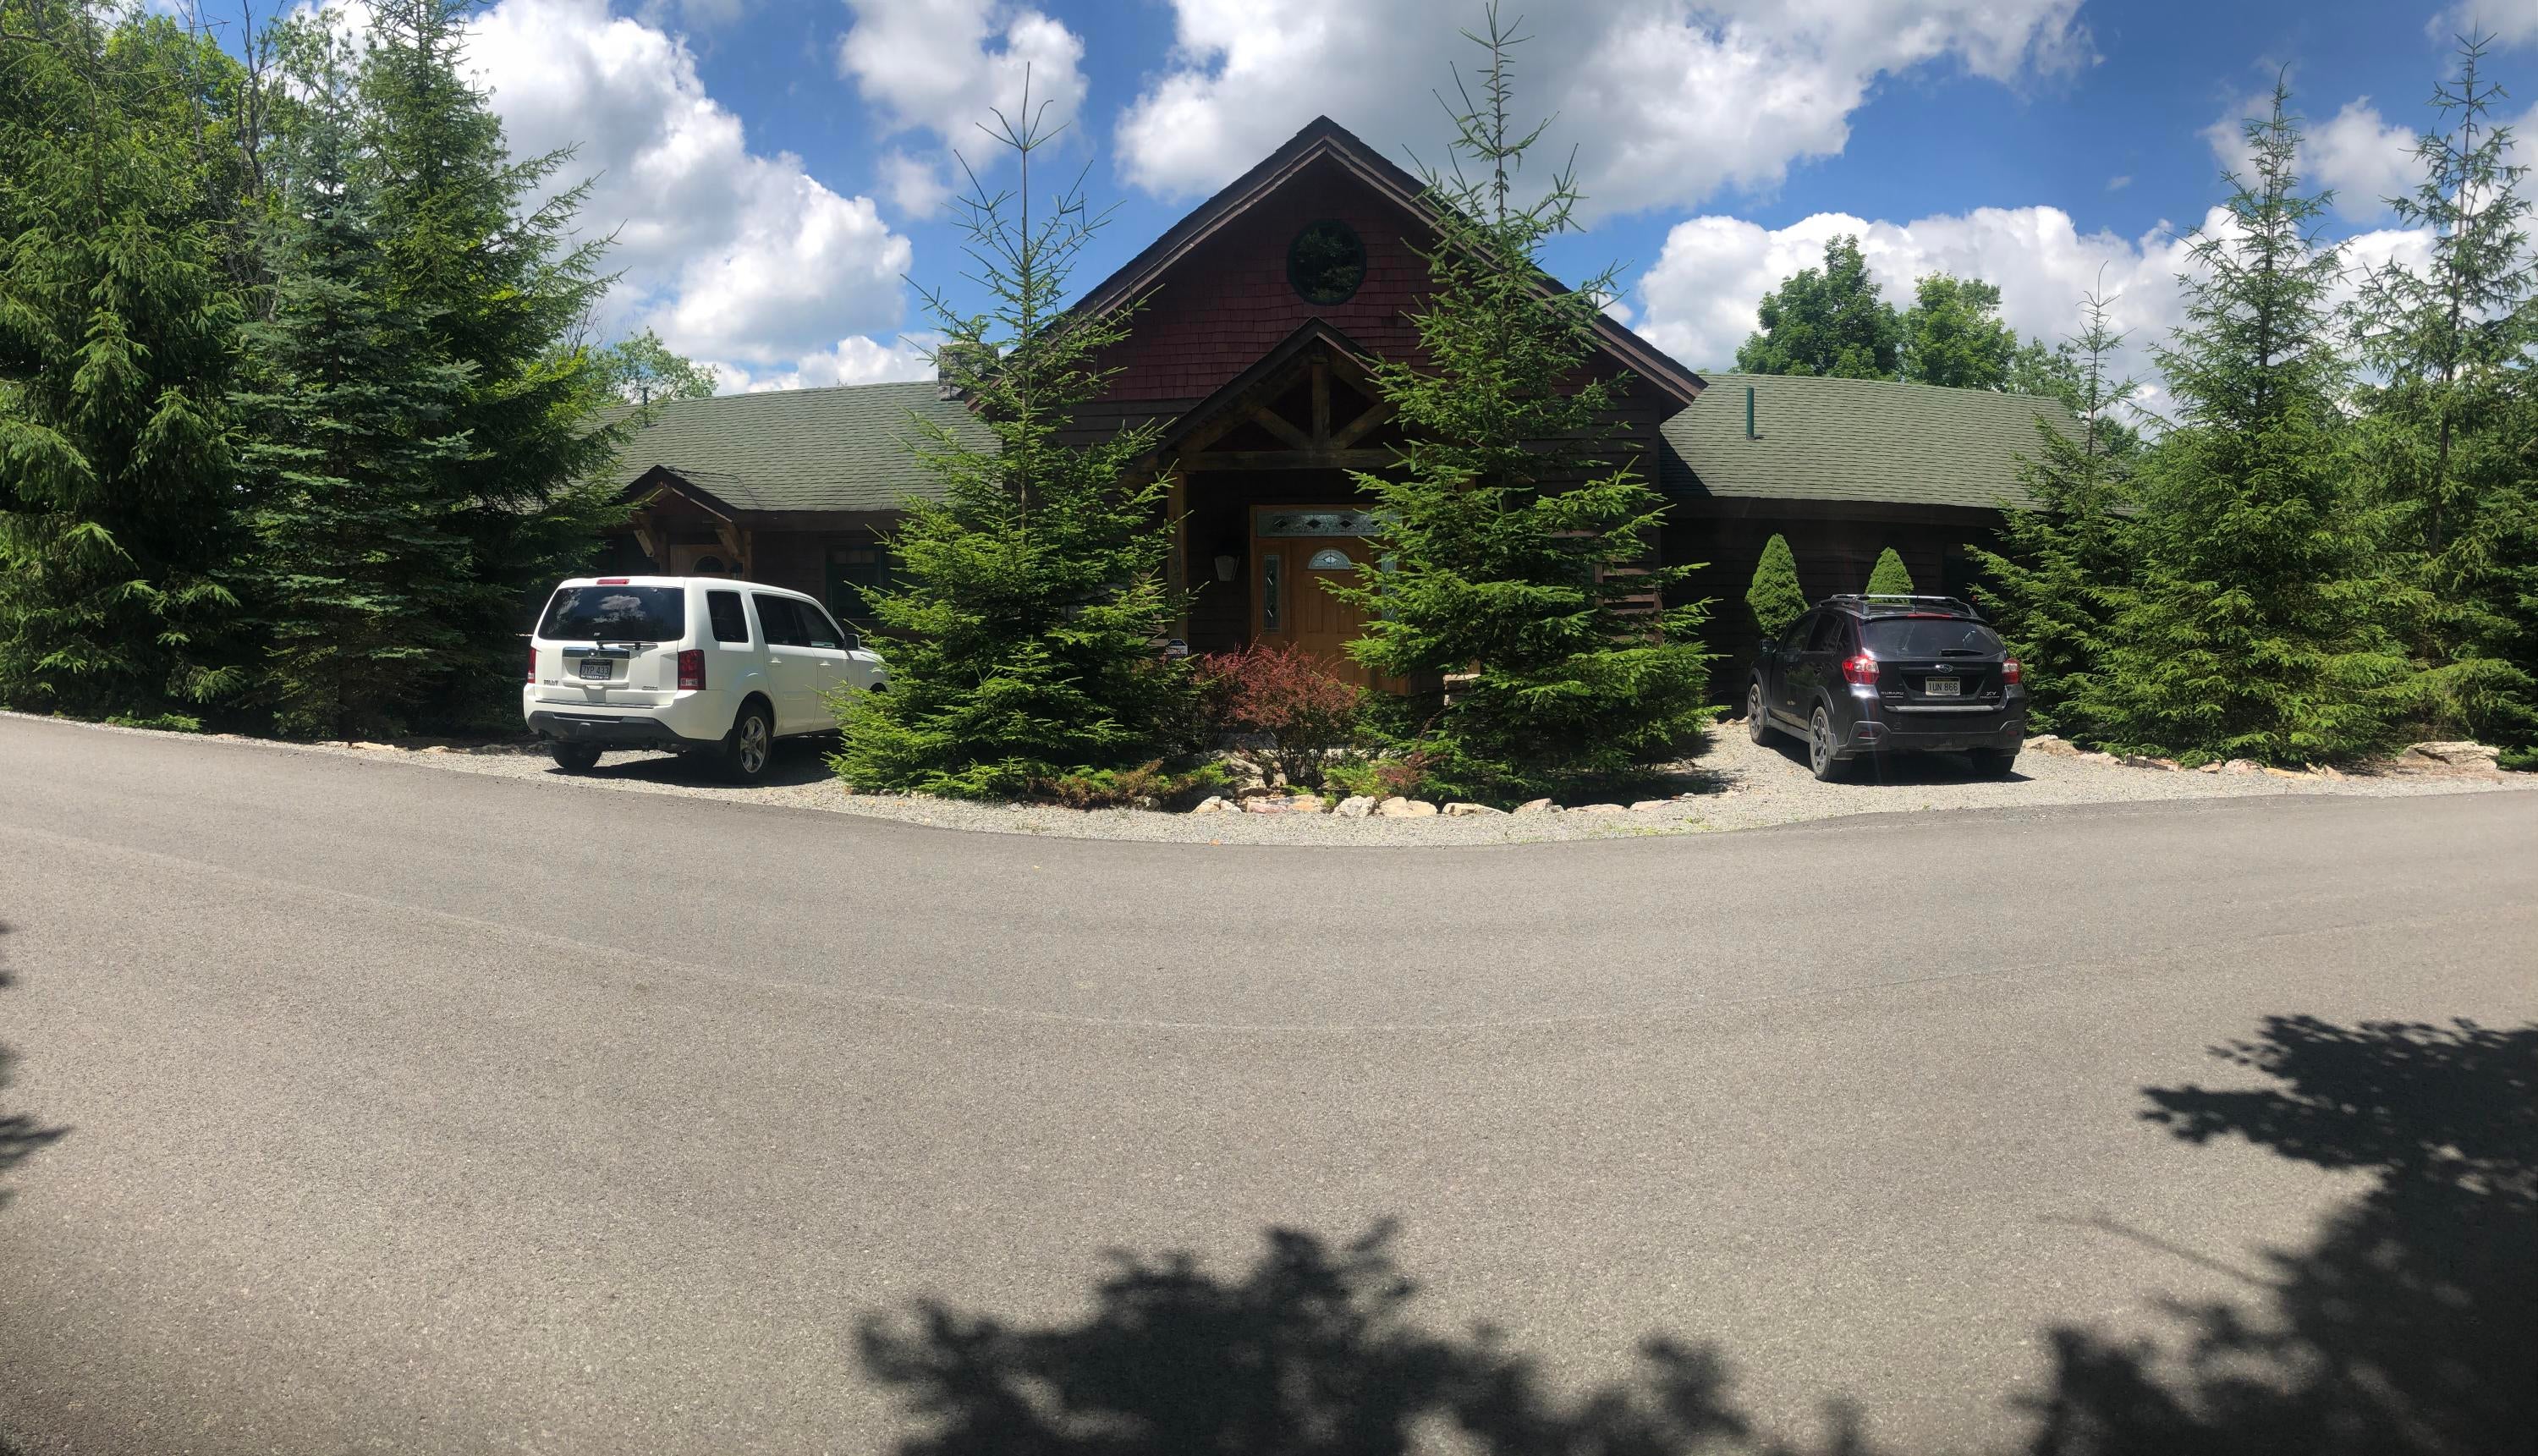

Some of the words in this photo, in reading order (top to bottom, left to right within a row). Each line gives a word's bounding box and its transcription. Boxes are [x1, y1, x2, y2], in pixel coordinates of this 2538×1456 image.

[582, 665, 594, 674] 7YP
[596, 666, 609, 675] 433
[1944, 683, 1958, 691] 866
